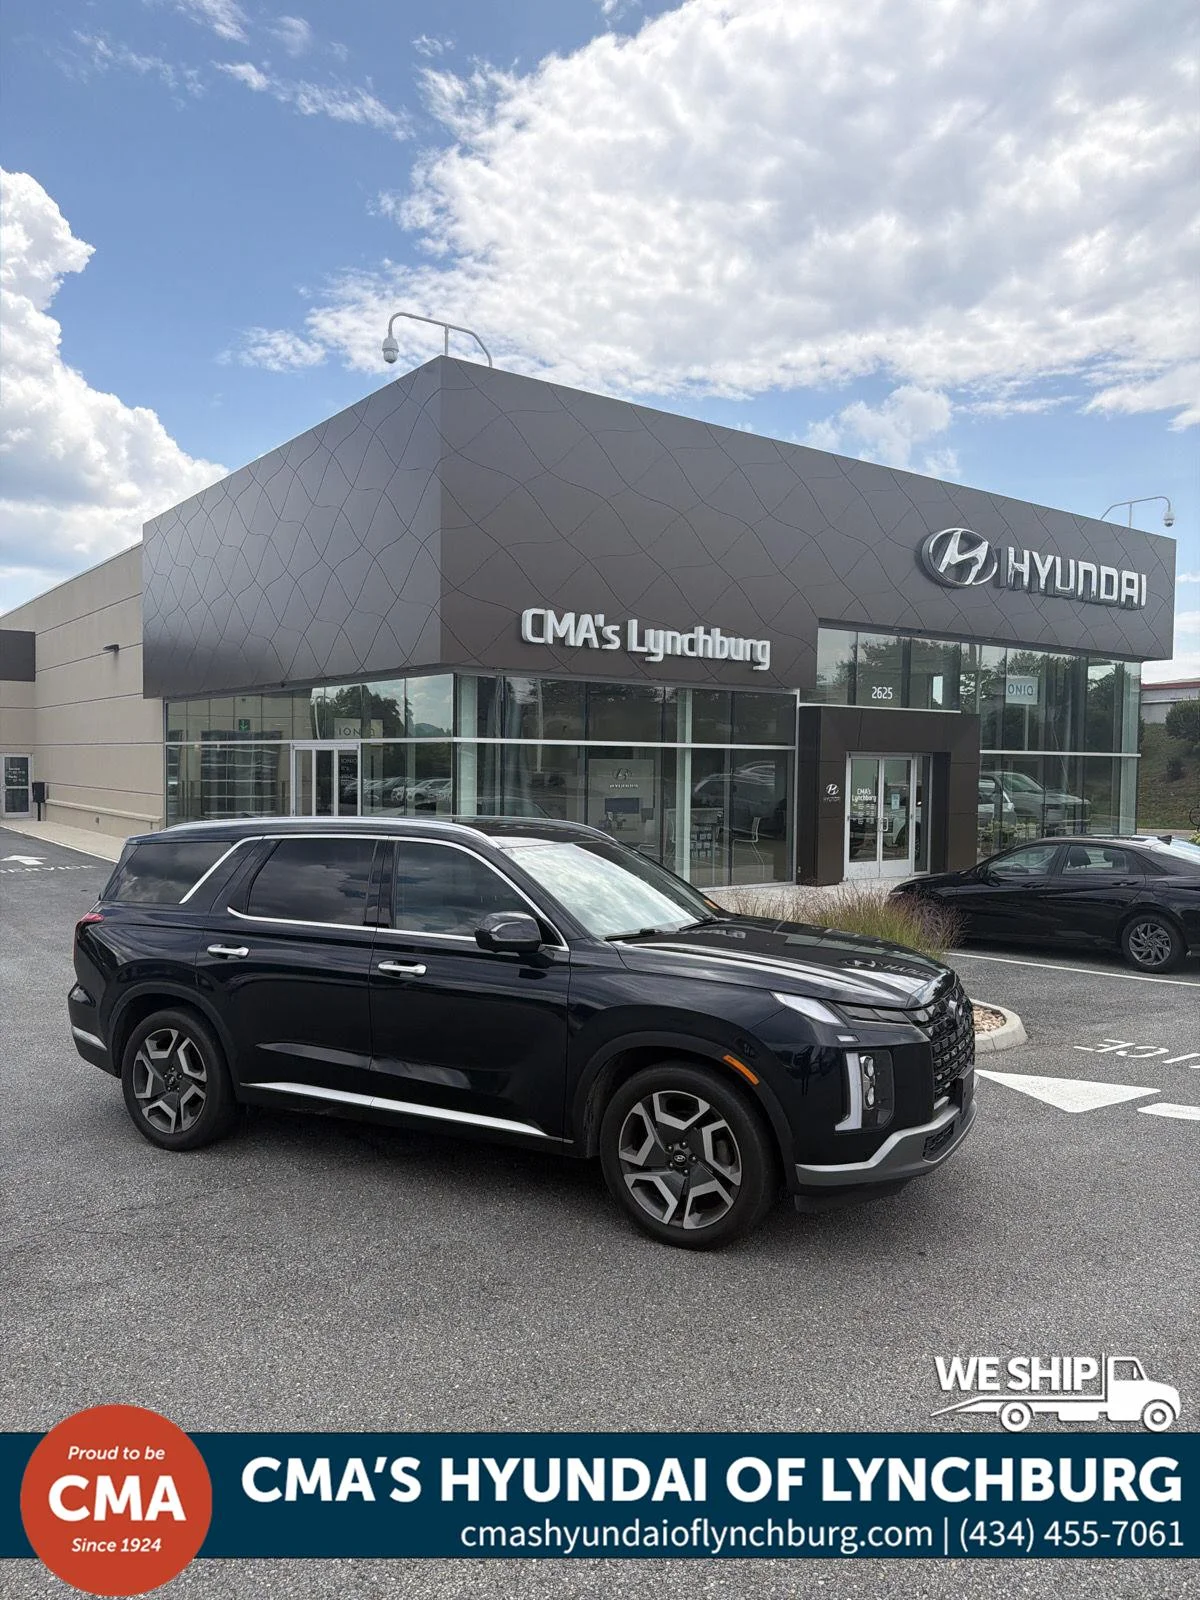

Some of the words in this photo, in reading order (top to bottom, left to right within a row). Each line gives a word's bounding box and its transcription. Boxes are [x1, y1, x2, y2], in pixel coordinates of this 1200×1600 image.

[1006, 546, 1147, 609] HYUNDAI
[521, 607, 621, 650] CMA's
[627, 618, 772, 671] Lynchburg
[871, 686, 893, 699] 2625
[1007, 683, 1034, 697] ONIQ
